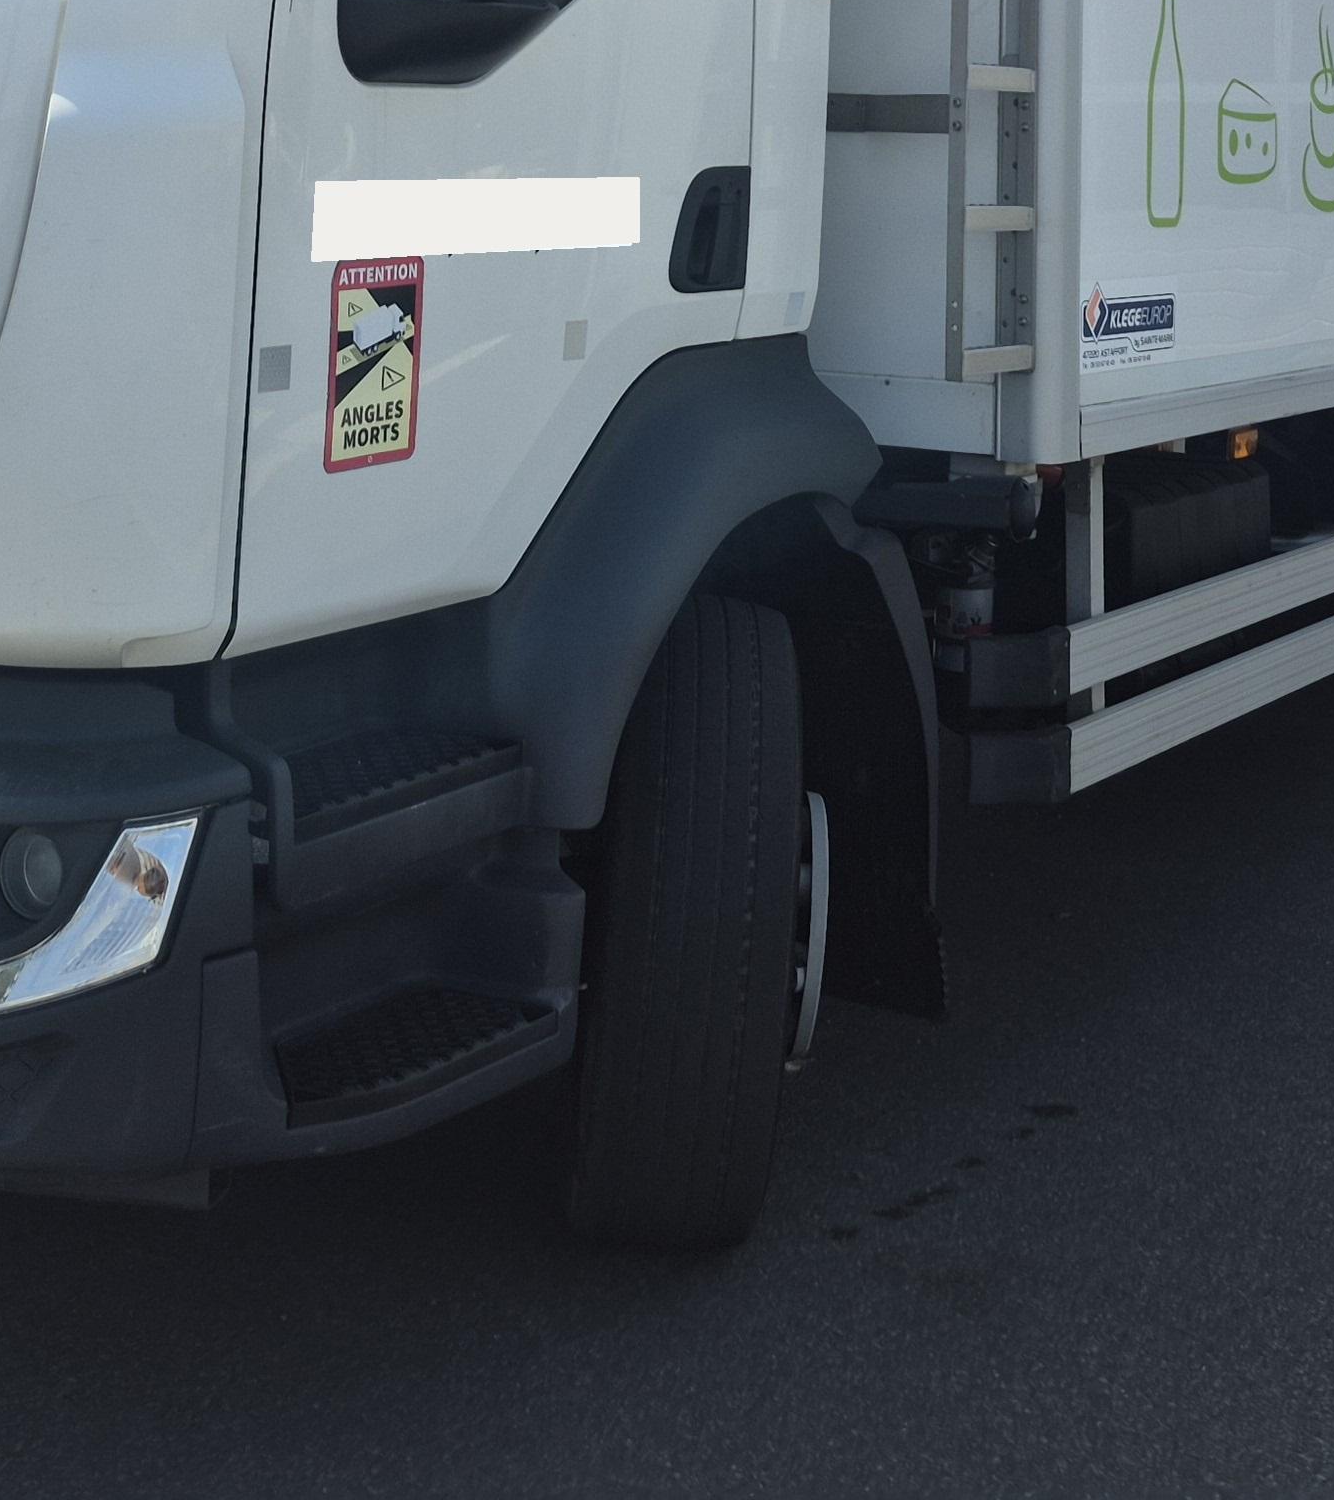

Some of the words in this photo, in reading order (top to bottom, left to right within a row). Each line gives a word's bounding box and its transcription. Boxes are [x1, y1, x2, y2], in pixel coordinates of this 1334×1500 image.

[338, 263, 418, 286] ATTENTION
[340, 399, 404, 428] ANGLES
[343, 422, 400, 451] MORTS
